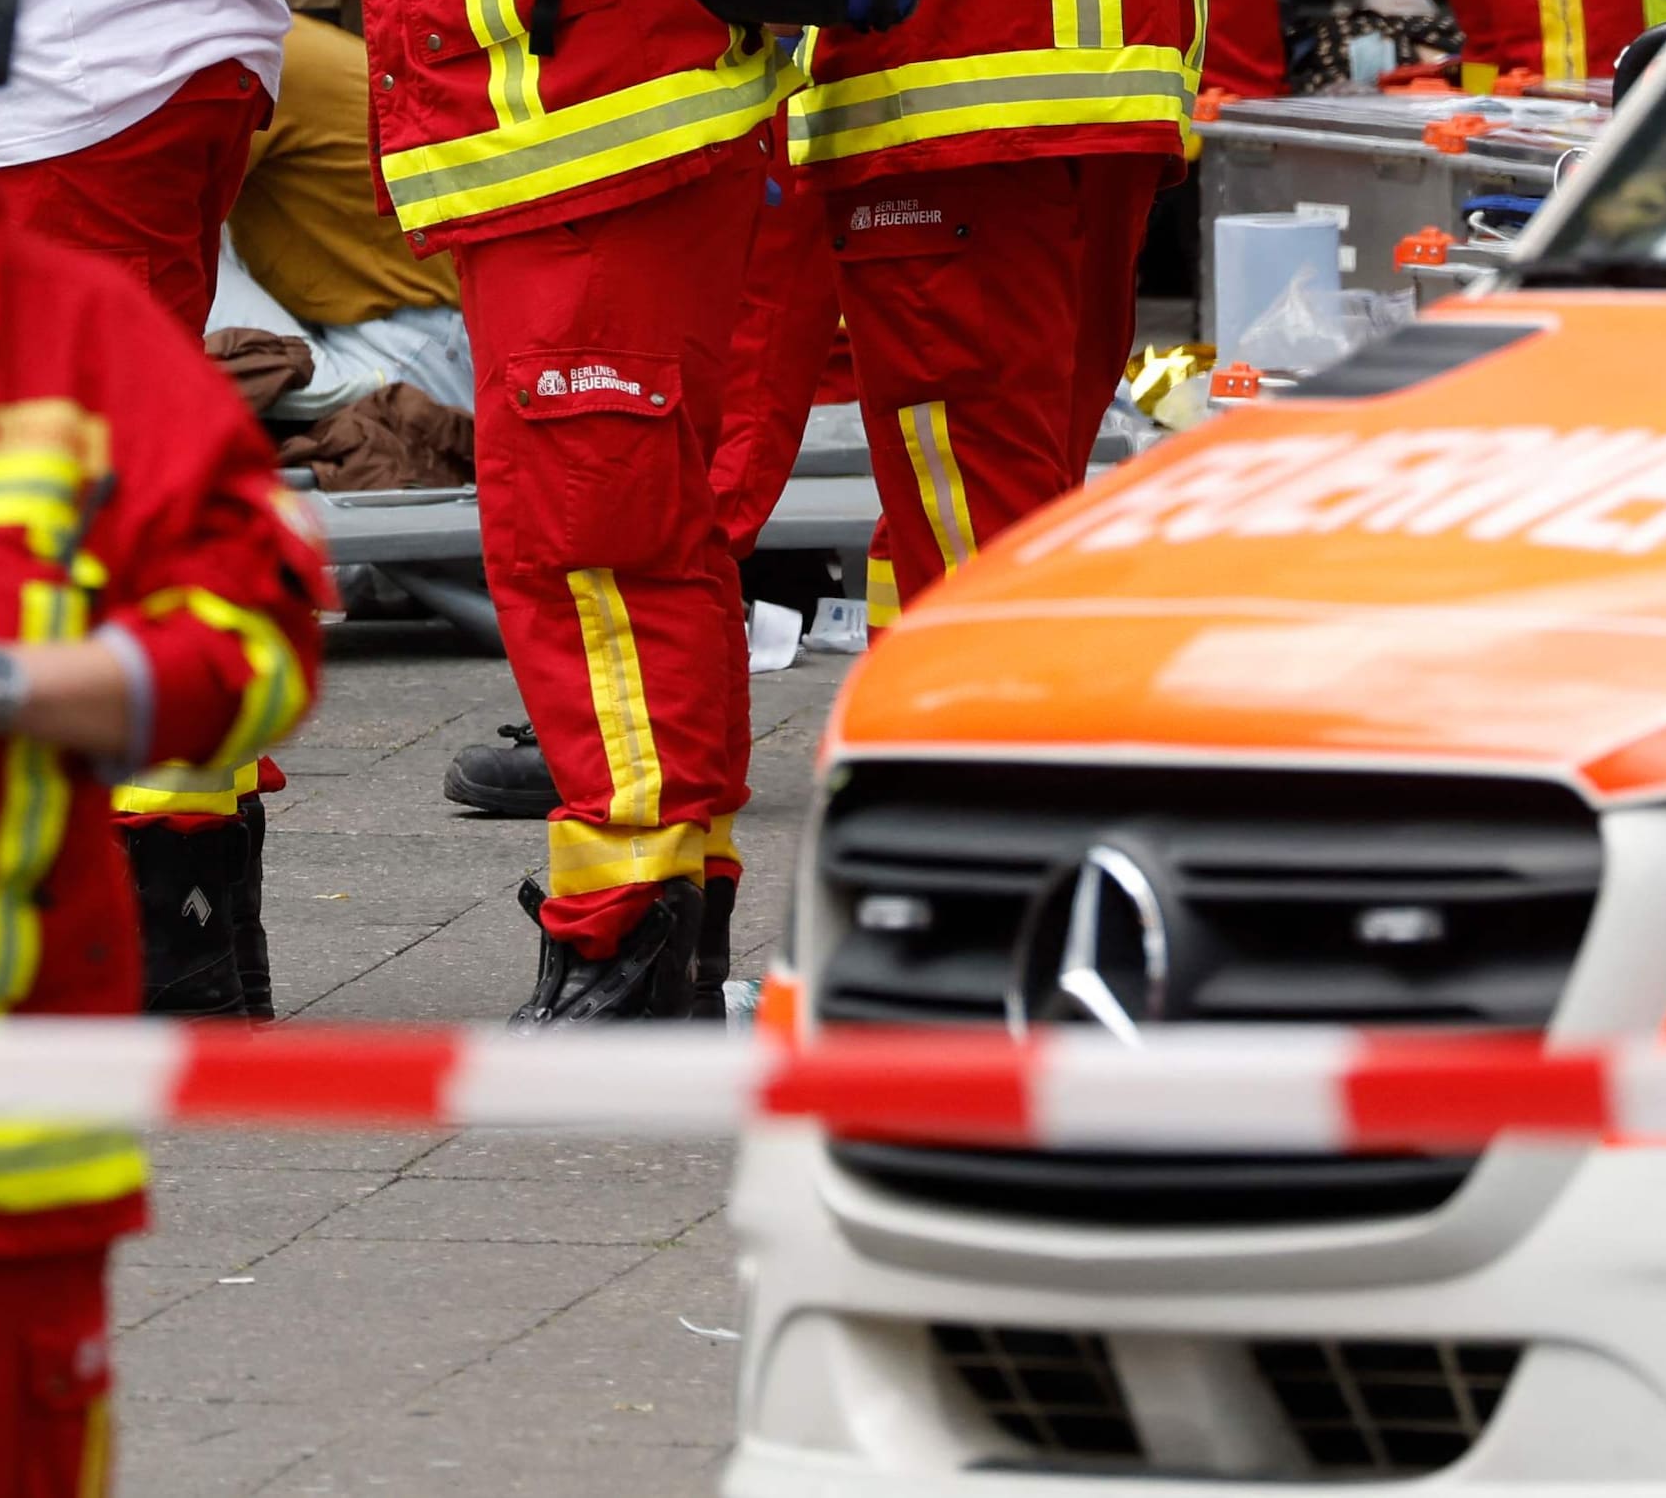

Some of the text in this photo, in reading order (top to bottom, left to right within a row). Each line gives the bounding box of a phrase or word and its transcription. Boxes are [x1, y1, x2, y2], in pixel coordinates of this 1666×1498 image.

[874, 199, 919, 213] BERLINER
[874, 210, 943, 227] FEUERWEHR
[570, 365, 618, 380] BERLINER
[571, 377, 641, 395] FEUERWEHR
